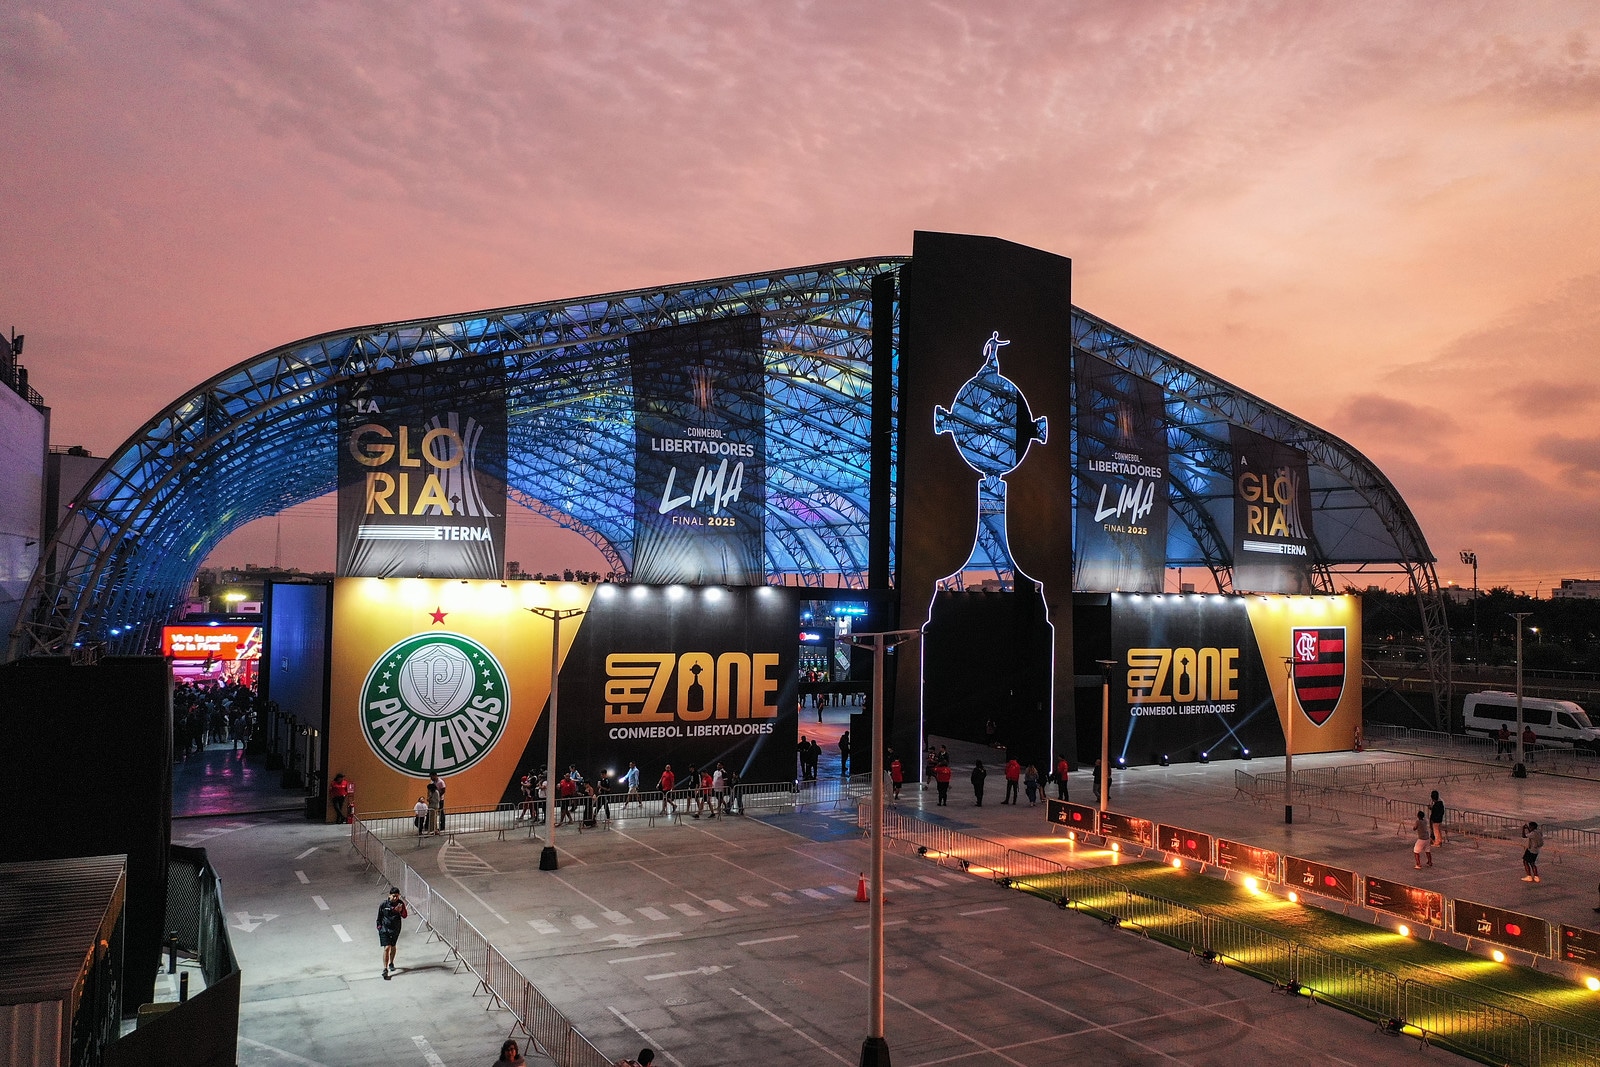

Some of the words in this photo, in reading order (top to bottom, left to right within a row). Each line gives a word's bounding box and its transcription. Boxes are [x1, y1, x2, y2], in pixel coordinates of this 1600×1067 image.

[357, 400, 381, 414] LA
[687, 427, 723, 439] CONMEBOL
[651, 438, 754, 457] LIBERTADORES
[1114, 452, 1140, 462] CONMEBOL
[1088, 460, 1162, 478] LIBERTADORES
[659, 458, 744, 515] LIMA
[1094, 478, 1155, 525] LIMA
[672, 516, 704, 526] FINAL
[707, 517, 736, 527] 2025
[1103, 524, 1125, 533] FINAL
[1127, 526, 1147, 535] 2025
[434, 526, 493, 542] ETERNA
[1279, 543, 1307, 556] ETERNA
[1149, 647, 1240, 702] ZONE
[640, 652, 780, 723] ZONE
[1130, 706, 1178, 717] CONMEBOL
[1179, 703, 1236, 715] LIBERTADORES
[369, 695, 502, 770] PALMEIRAS
[608, 725, 684, 740] CONMEBOL
[687, 723, 774, 737] LIBERTADORES
